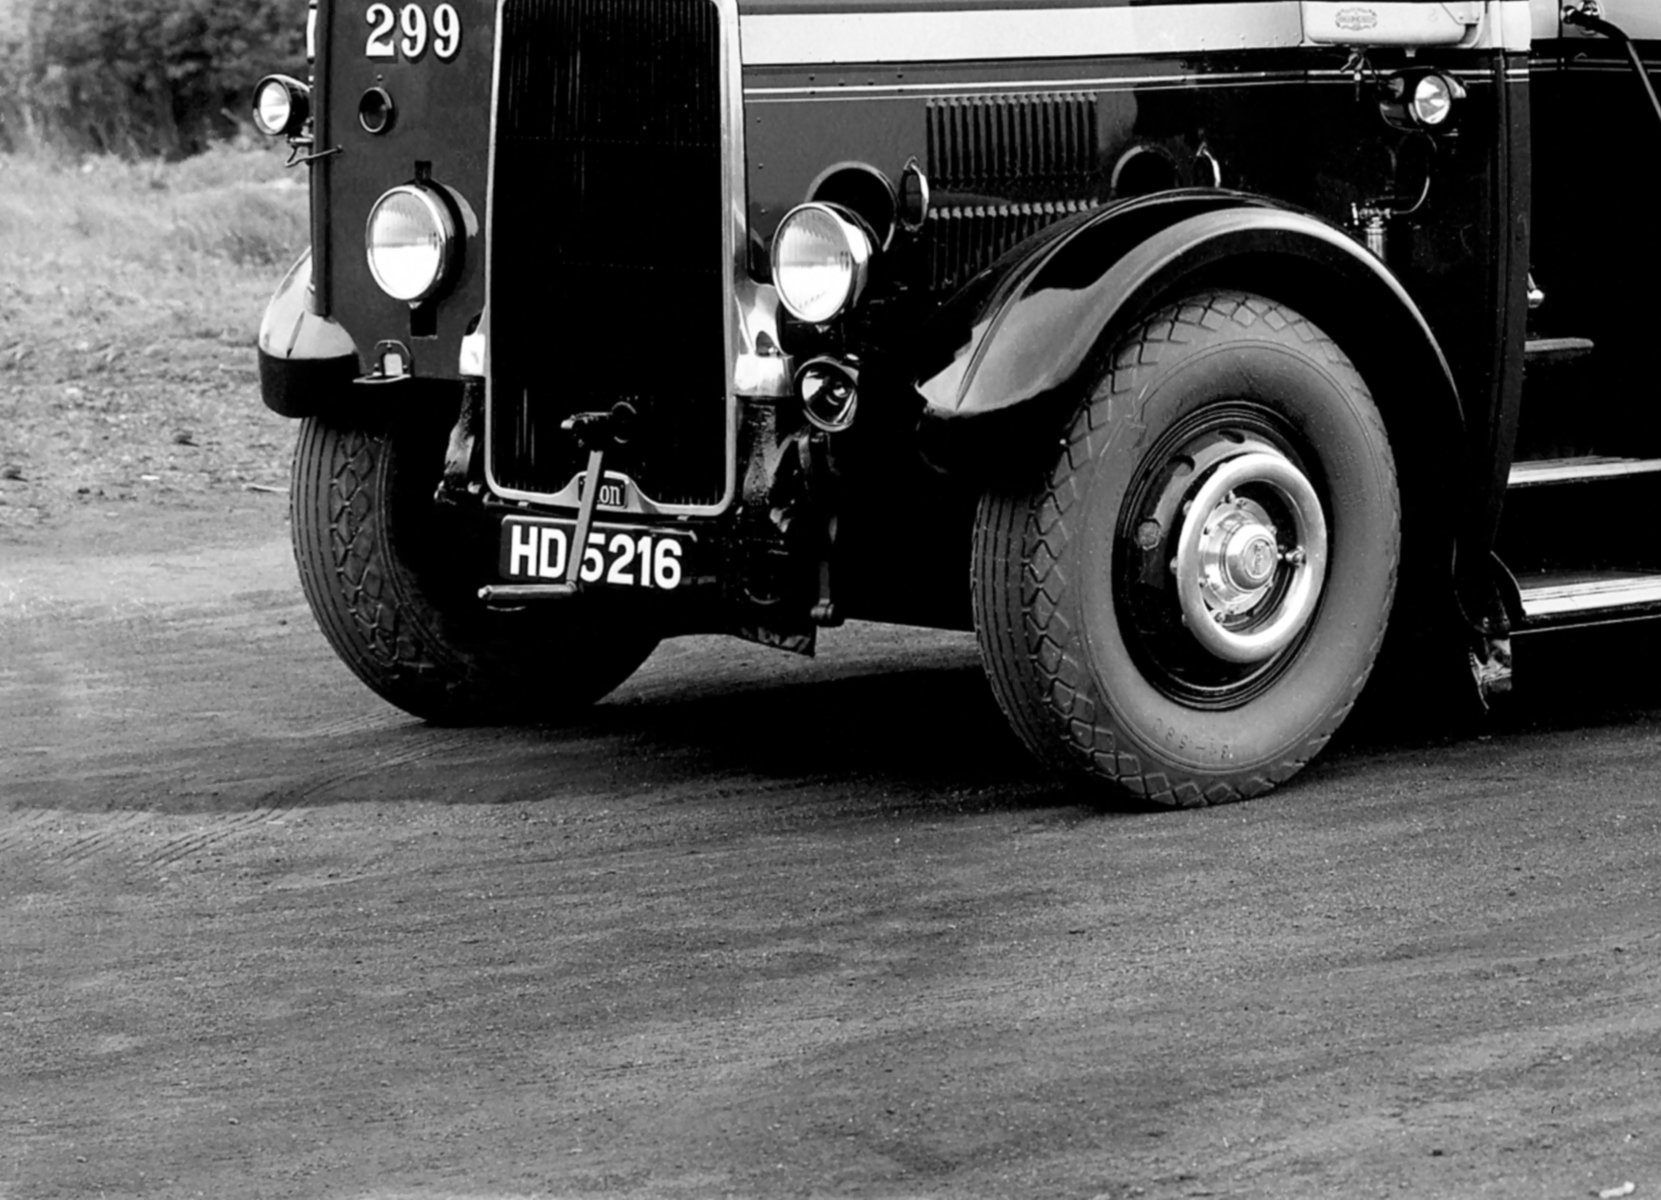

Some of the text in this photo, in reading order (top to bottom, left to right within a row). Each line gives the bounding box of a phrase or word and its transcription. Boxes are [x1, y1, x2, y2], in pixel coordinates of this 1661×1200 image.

[365, 3, 461, 58] 299
[510, 524, 683, 590] HD 5216
